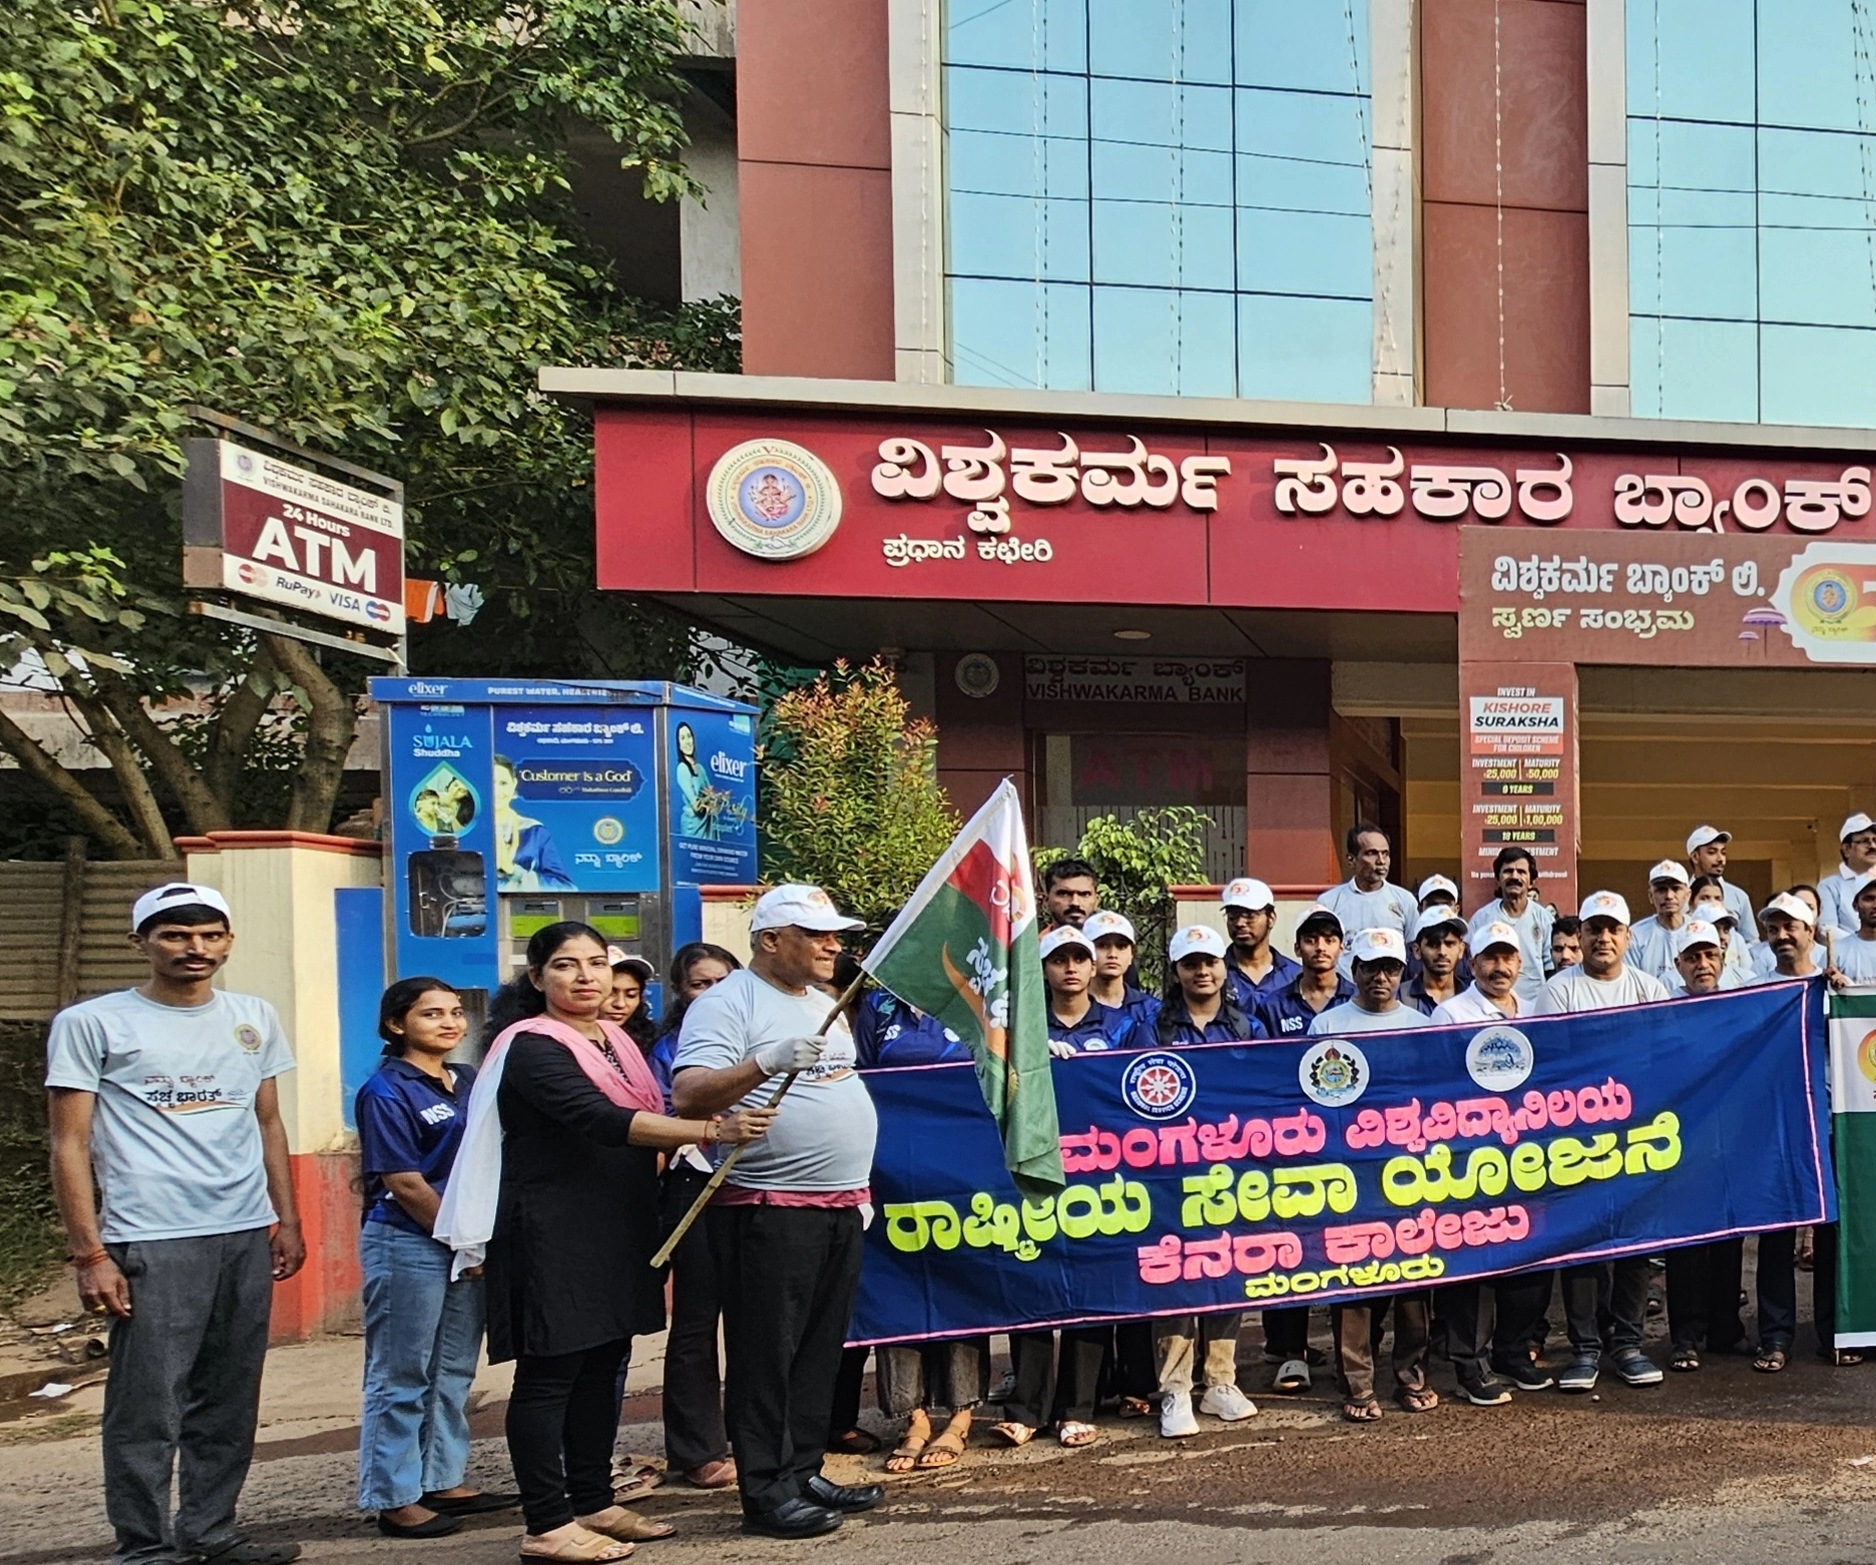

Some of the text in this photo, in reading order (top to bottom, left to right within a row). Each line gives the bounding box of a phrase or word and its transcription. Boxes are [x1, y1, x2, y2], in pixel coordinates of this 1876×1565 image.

[871, 429, 1232, 534] ವಿಶ್ವಕರ್ಮ
[1274, 441, 1574, 523] ಸಹಕಾರ
[1613, 466, 1873, 534] ಬ್ಯಾಂಕ್
[282, 504, 351, 537] 24 Hours
[252, 516, 376, 594] ATM
[883, 534, 1053, 566] ಪ್ರಧಾನ ಕಛೇರಿ
[1491, 554, 1618, 599] ವಿಶ್ವಕರ್ಮ
[1627, 559, 1724, 602] ಬ್ಯಾಂಕ್
[276, 577, 360, 612] RuPay VISA
[1492, 607, 1695, 639] ಸ್ವರ್ಣ ಸಂಭ್ರಮ
[1028, 684, 1243, 702] VISHWAKARMA BANK
[1497, 687, 1536, 697] INVEST IN
[1483, 702, 1552, 713] KISHORE
[1474, 716, 1559, 727] SURAKSHA
[413, 735, 473, 749] SUJALA
[413, 748, 461, 758] Shuddha
[1472, 759, 1561, 768] INVESTMENT MATURITY
[1510, 785, 1533, 794] YEARS
[1472, 804, 1561, 814] INVESTMENT MATURITY
[1512, 832, 1536, 841] YEARS
[884, 1024, 901, 1040] SS
[1280, 1016, 1303, 1033] NSS
[420, 1103, 455, 1126] NSS
[1059, 1076, 1632, 1174] ಮಂಗಳೂರು ವಿಶ್ವವಿದ್ಯಾನಿಲಯ
[884, 1111, 1682, 1262] ರಾಷ್ಟ್ರೀಯ ಸೇವಾ ಯೋಜನೆ
[1137, 1205, 1529, 1284] ಕೆನರಾ ಕಾಲೇಜು
[1244, 1253, 1444, 1298] ಮಂಗಳೂರು
